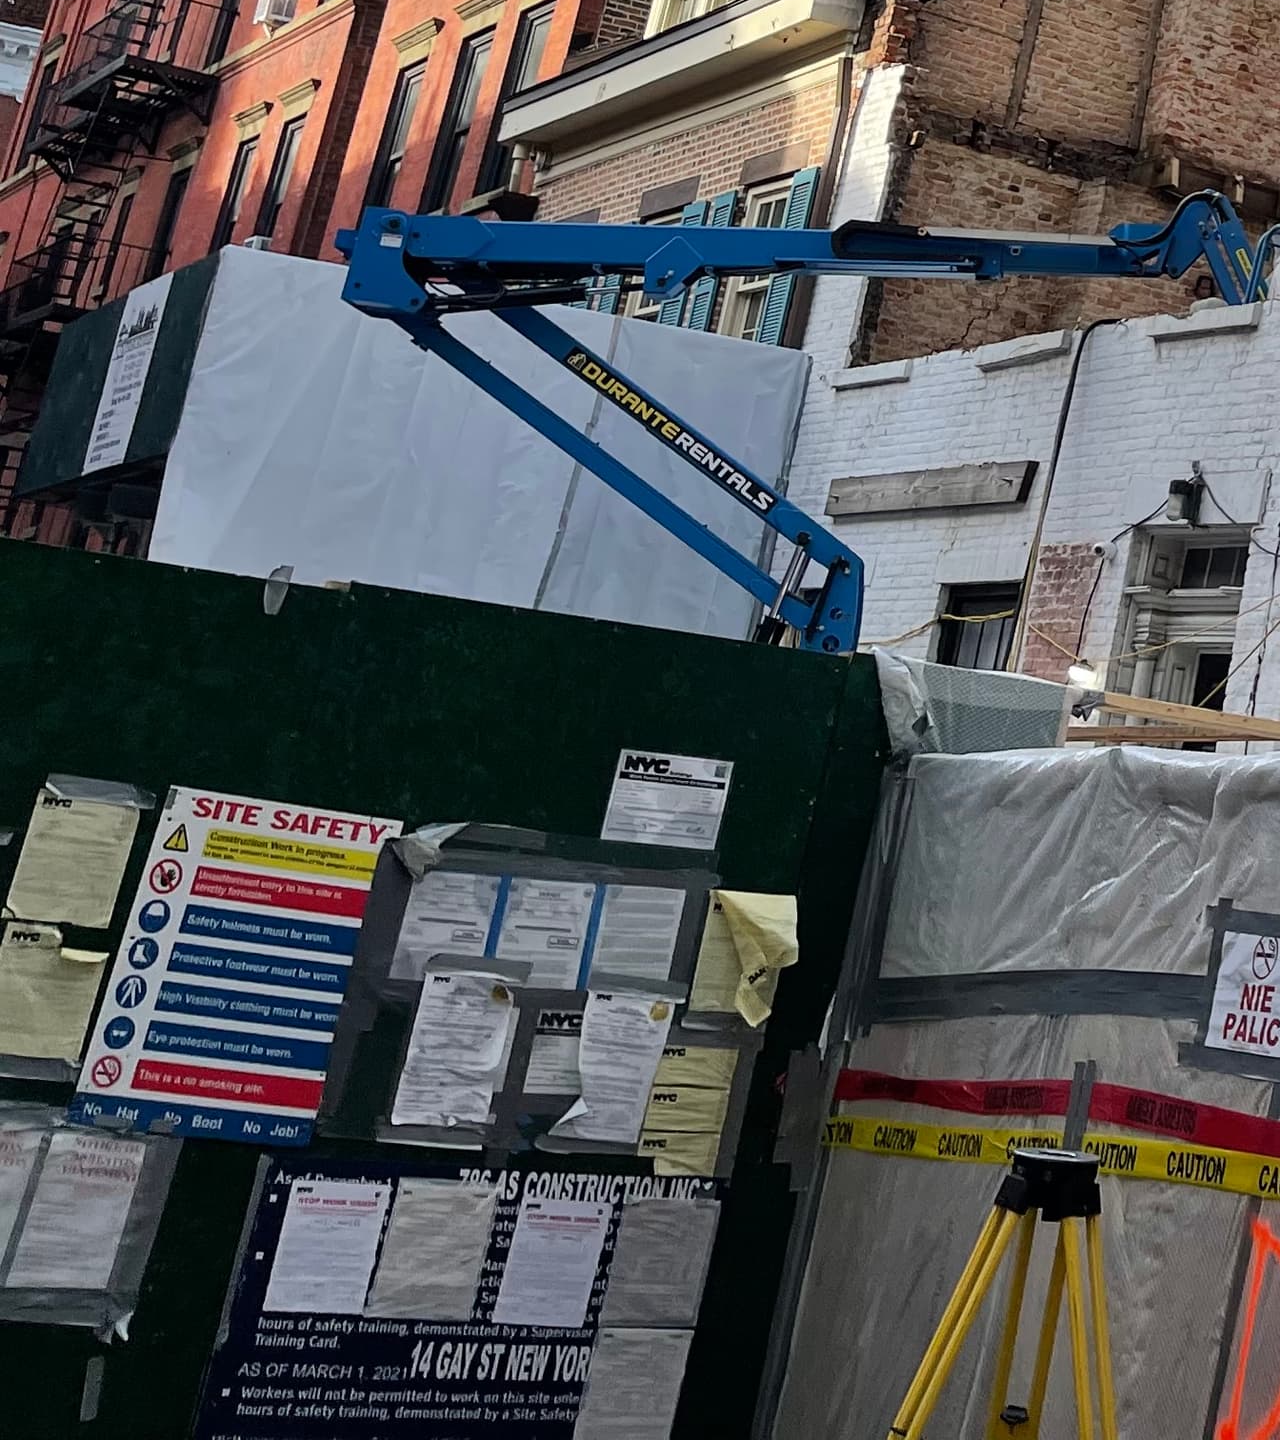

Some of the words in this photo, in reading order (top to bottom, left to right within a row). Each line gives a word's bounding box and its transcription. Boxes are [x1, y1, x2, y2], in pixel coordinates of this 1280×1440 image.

[624, 755, 670, 774] NYC
[43, 797, 73, 808] NYC
[193, 797, 262, 826] SITE
[270, 810, 387, 844] SAFETY
[210, 832, 268, 849] Construction
[271, 841, 293, 853] Work
[296, 845, 305, 854] in
[11, 930, 40, 942] NYC
[187, 914, 220, 929] Safety
[263, 926, 288, 938] must
[290, 929, 302, 939] be
[172, 951, 223, 967] Protective
[225, 958, 269, 972] footwear
[271, 965, 296, 977] must
[298, 968, 310, 978] be
[158, 990, 182, 1004] High
[185, 994, 228, 1010] Visibility
[230, 1000, 270, 1016] clothing
[273, 1006, 297, 1017] must
[300, 1009, 312, 1019] be
[1239, 982, 1277, 1013] NIE
[539, 1012, 583, 1028] NYC
[1222, 1012, 1280, 1047] PALIC
[148, 1029, 168, 1044] Eye
[169, 1034, 221, 1052] protection
[224, 1042, 249, 1054] must
[251, 1044, 264, 1055] be
[138, 1069, 160, 1083] This
[162, 1072, 171, 1083] is
[174, 1075, 181, 1085] a
[183, 1076, 197, 1086] no
[199, 1077, 242, 1094] smoking
[83, 1102, 102, 1116] No
[116, 1106, 139, 1120] Hat
[164, 1111, 181, 1126] No
[243, 1120, 261, 1134] No
[270, 1124, 298, 1139] Job!
[873, 1125, 917, 1153] CAUTION
[938, 1132, 983, 1158] CAUTION
[1085, 1141, 1137, 1172] CAUTION
[1167, 1151, 1226, 1185] CAUTION
[499, 1169, 520, 1201] AS
[524, 1171, 668, 1205] CONSTRUCTION
[668, 1178, 701, 1201] INC
[258, 1316, 294, 1330] hours
[298, 1318, 312, 1330] of
[315, 1320, 354, 1335] safety
[358, 1321, 409, 1337] training,
[414, 1322, 500, 1337] demonstrated
[503, 1326, 517, 1339] by
[520, 1328, 527, 1337] a
[531, 1327, 593, 1340] Supervisor
[255, 1333, 305, 1350] Training
[309, 1336, 341, 1349] Card.
[238, 1363, 261, 1377] AS
[266, 1363, 289, 1377] OF
[292, 1364, 352, 1379] MARCH
[372, 1366, 407, 1380] 2021
[410, 1340, 435, 1379] 14
[435, 1342, 478, 1380] GAY
[476, 1344, 505, 1381] ST
[504, 1344, 551, 1382] NEW
[553, 1345, 593, 1382] YOR
[241, 1386, 294, 1400] Workers
[299, 1387, 321, 1400] will
[325, 1389, 346, 1401] not
[350, 1388, 365, 1402] be
[368, 1389, 431, 1404] permitted
[435, 1391, 448, 1403] to
[451, 1392, 479, 1404] work
[484, 1394, 499, 1404] on
[503, 1392, 525, 1405] this
[528, 1393, 550, 1405] site
[554, 1394, 581, 1406] unle
[236, 1403, 274, 1416] hours
[277, 1404, 291, 1417] of
[295, 1405, 335, 1420] safety
[339, 1405, 390, 1421] training,
[395, 1406, 481, 1420] demonstrated
[484, 1408, 499, 1423] by
[503, 1411, 509, 1421] a
[513, 1408, 536, 1421] Site
[539, 1409, 577, 1423] Safety
